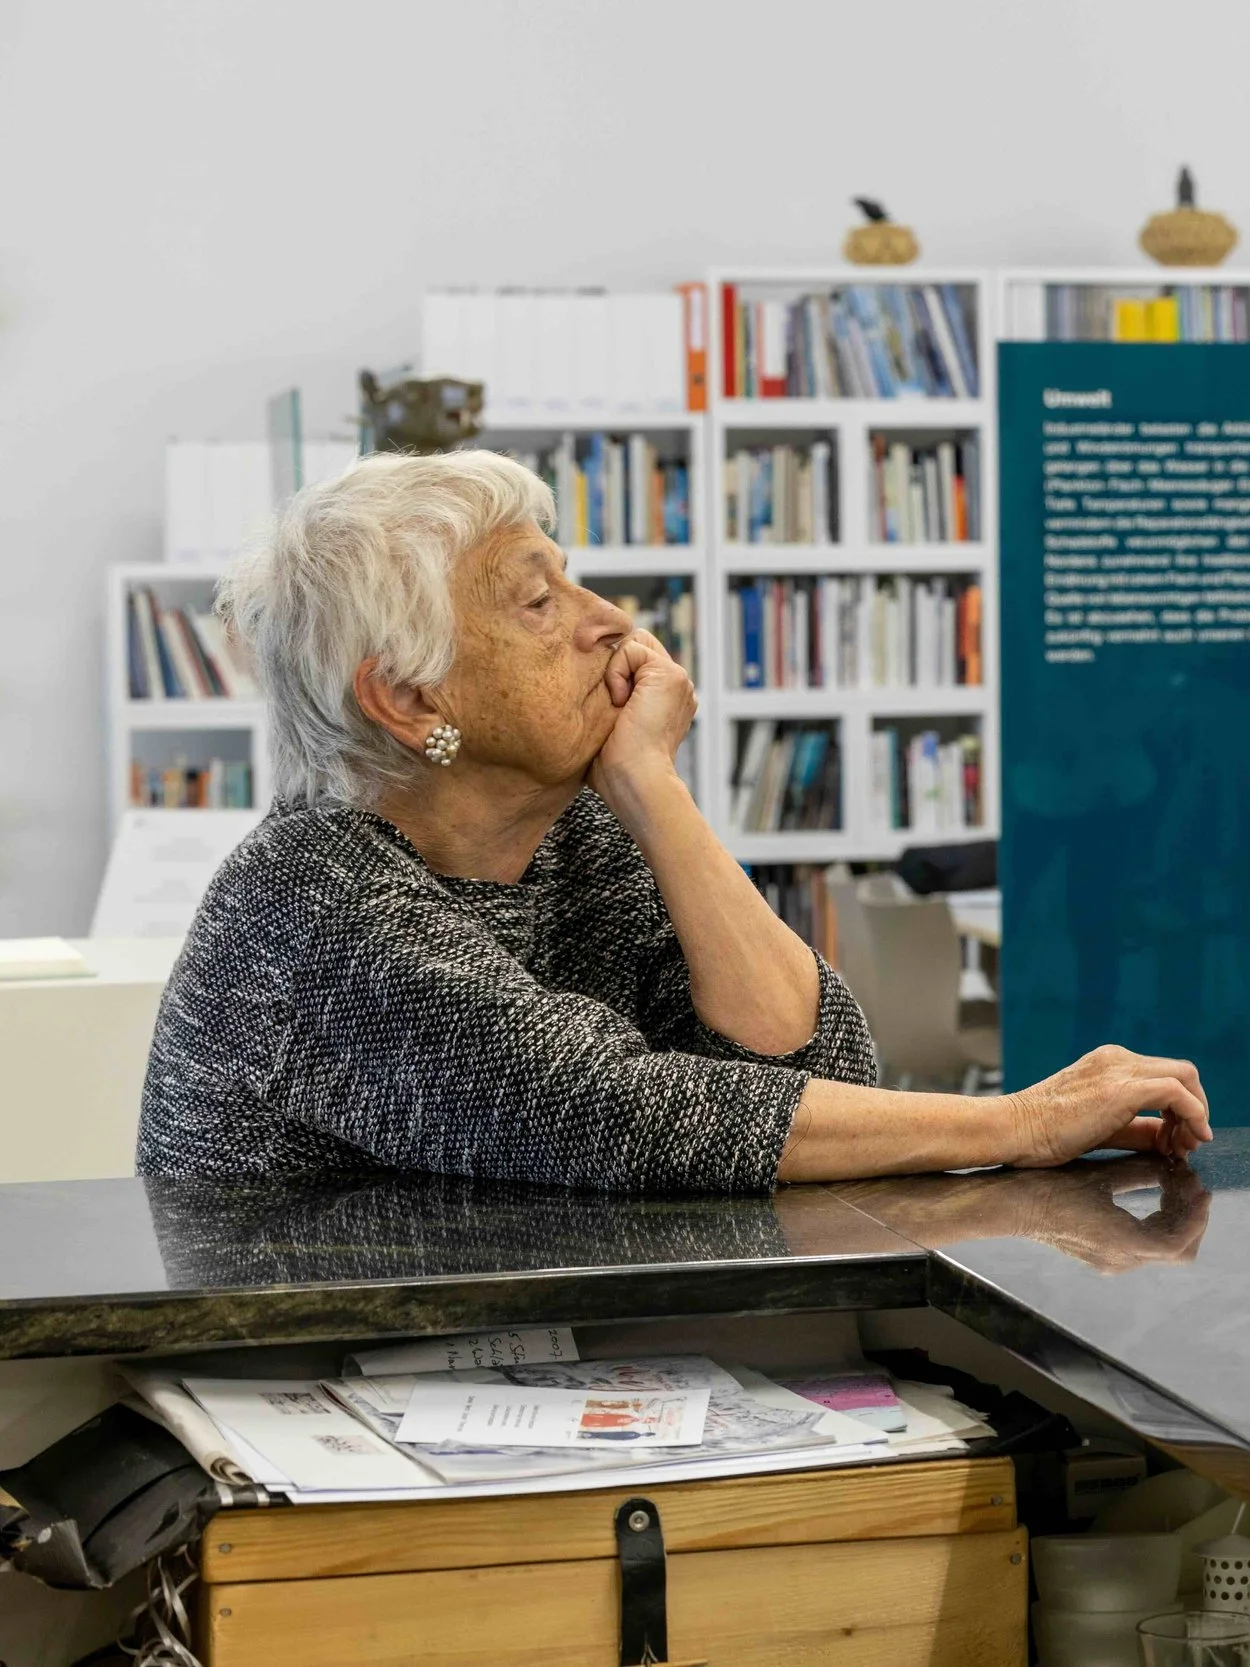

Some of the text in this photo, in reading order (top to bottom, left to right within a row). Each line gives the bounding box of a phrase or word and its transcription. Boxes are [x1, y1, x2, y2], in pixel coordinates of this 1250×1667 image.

[1044, 390, 1111, 408] Umwelt
[508, 1331, 522, 1342] 5
[548, 1329, 563, 1360] 2007
